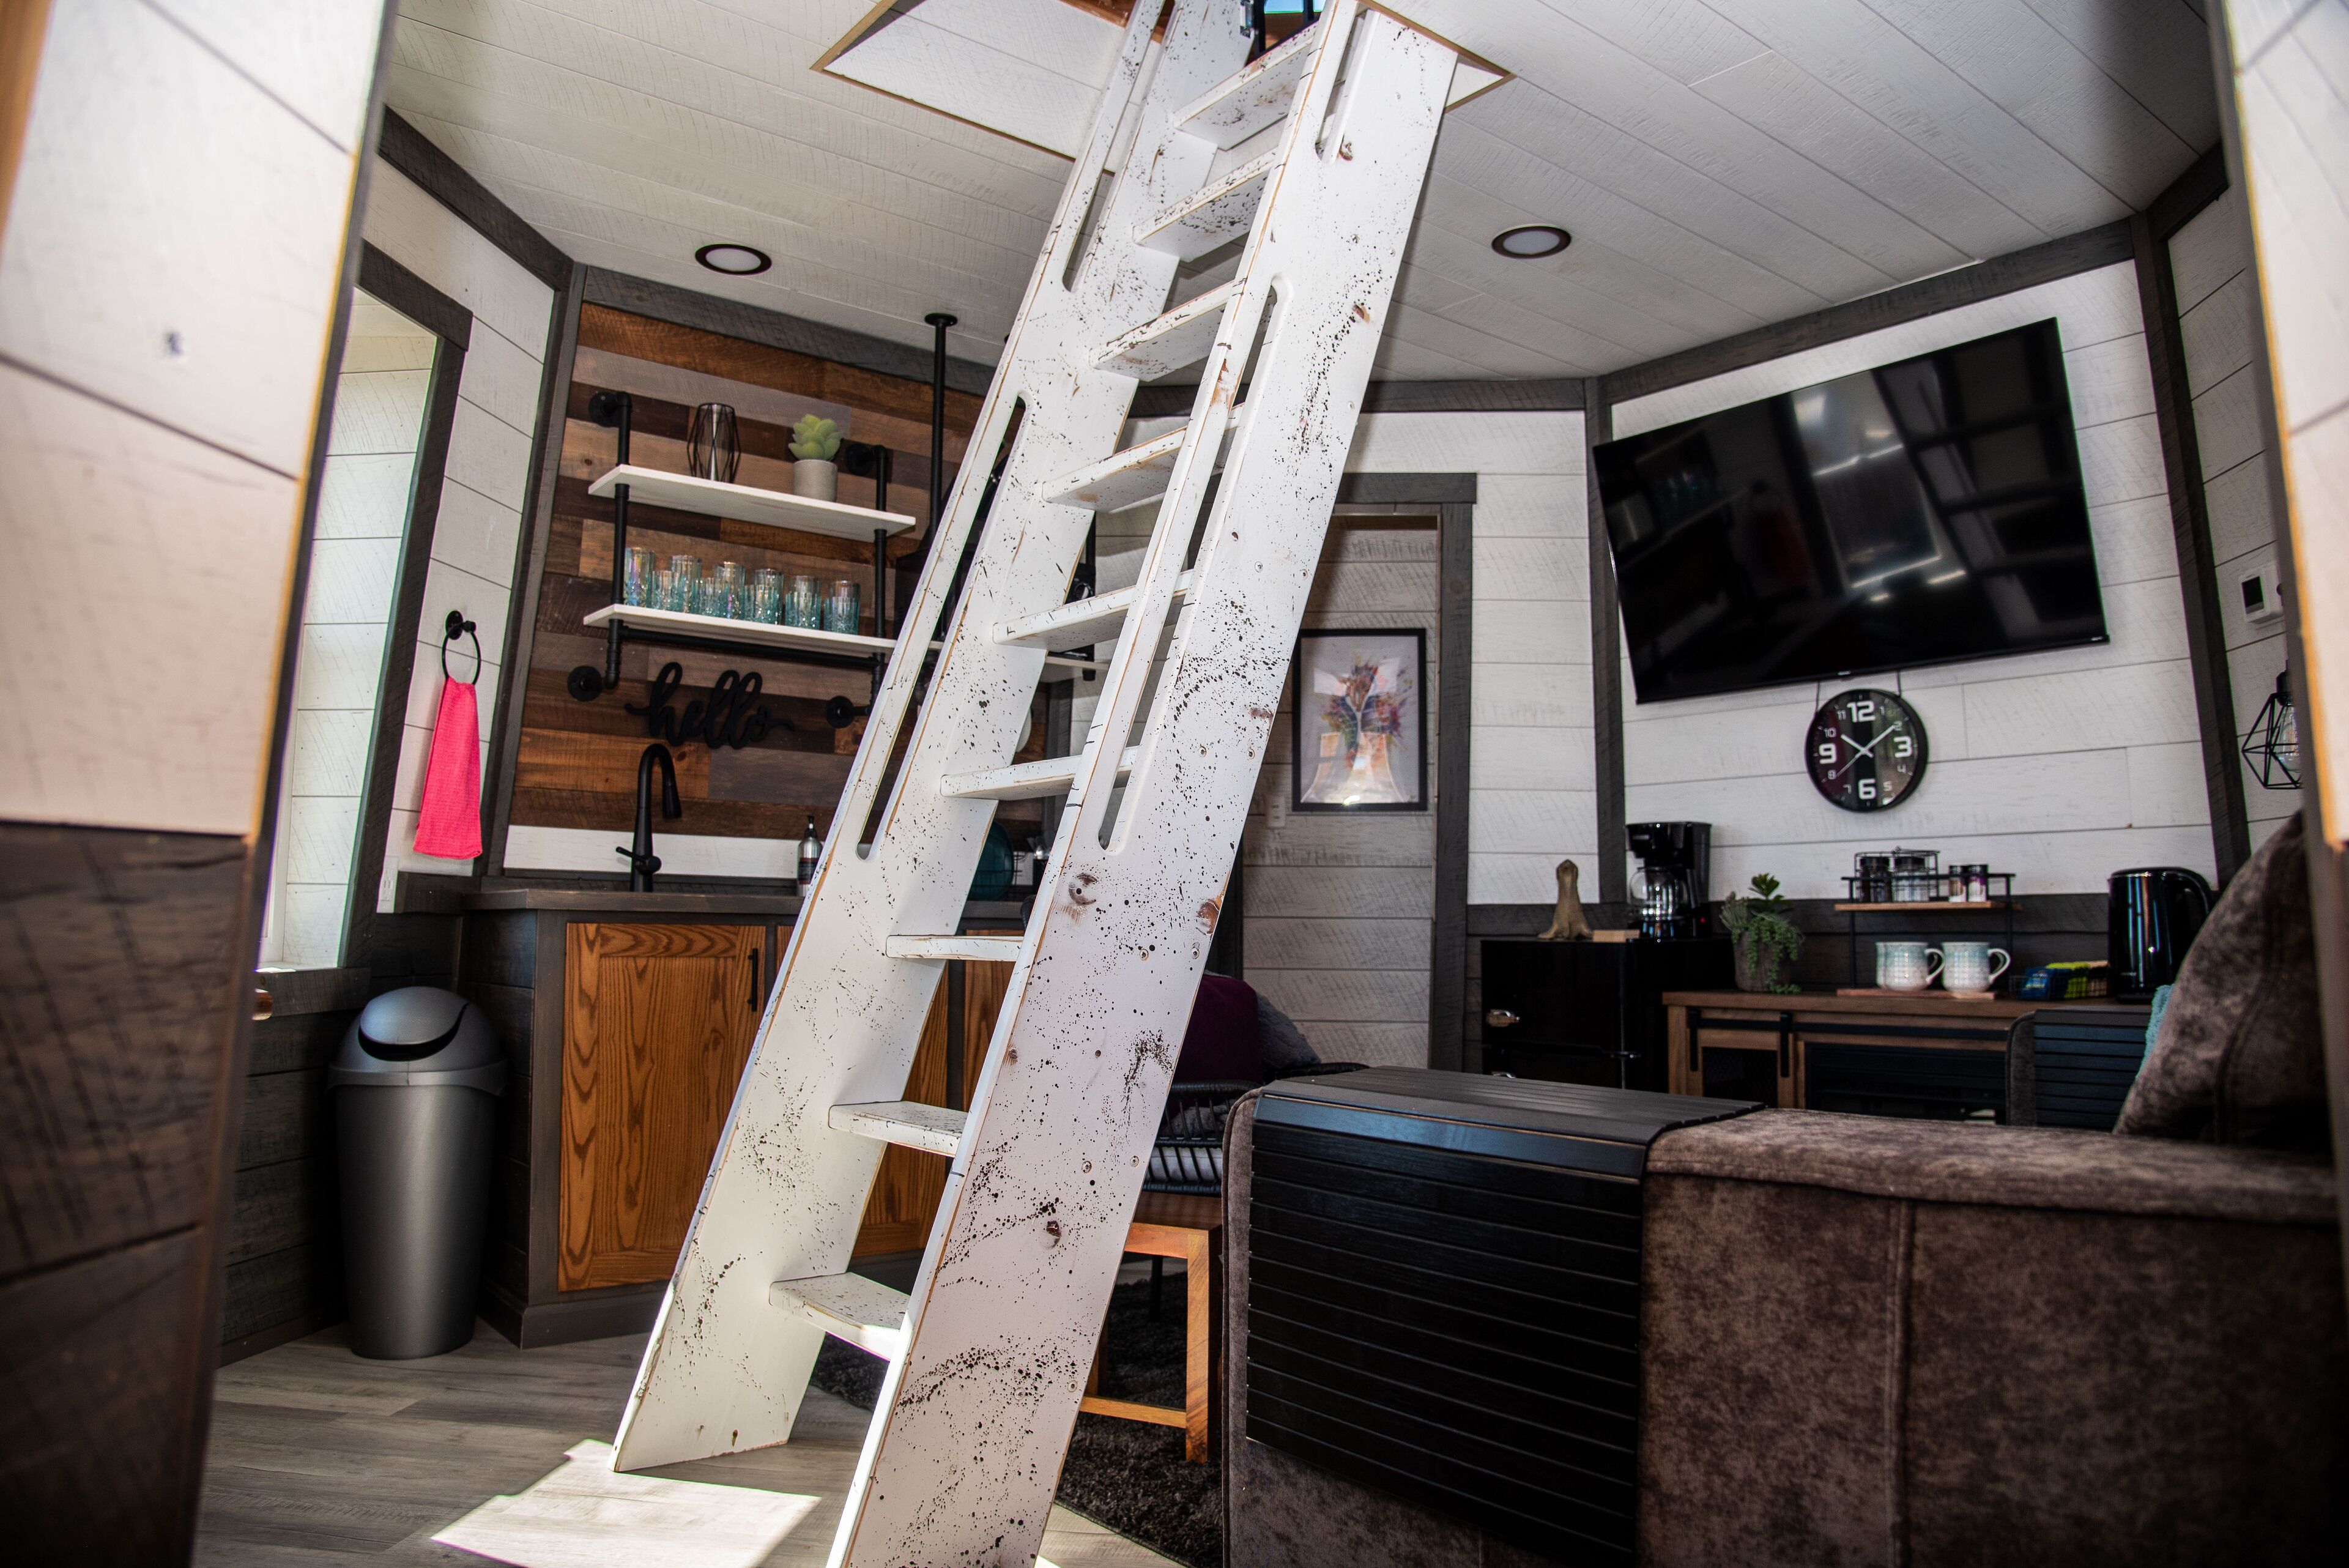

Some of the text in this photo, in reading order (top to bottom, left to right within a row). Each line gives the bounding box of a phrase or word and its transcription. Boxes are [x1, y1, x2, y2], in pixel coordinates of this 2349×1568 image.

[625, 661, 795, 749] hello
[1879, 706, 1885, 715] 1
[1837, 710, 1846, 720] 11
[1847, 700, 1876, 723] 12
[1894, 721, 1902, 730] 2
[1824, 727, 1836, 738] 10
[1893, 736, 1912, 757] 3
[1819, 743, 1838, 764] 9
[1827, 769, 1836, 780] 8
[1897, 764, 1907, 774] 4
[1842, 784, 1852, 794] 7
[1858, 778, 1876, 800] 6
[1883, 781, 1893, 791] 5
